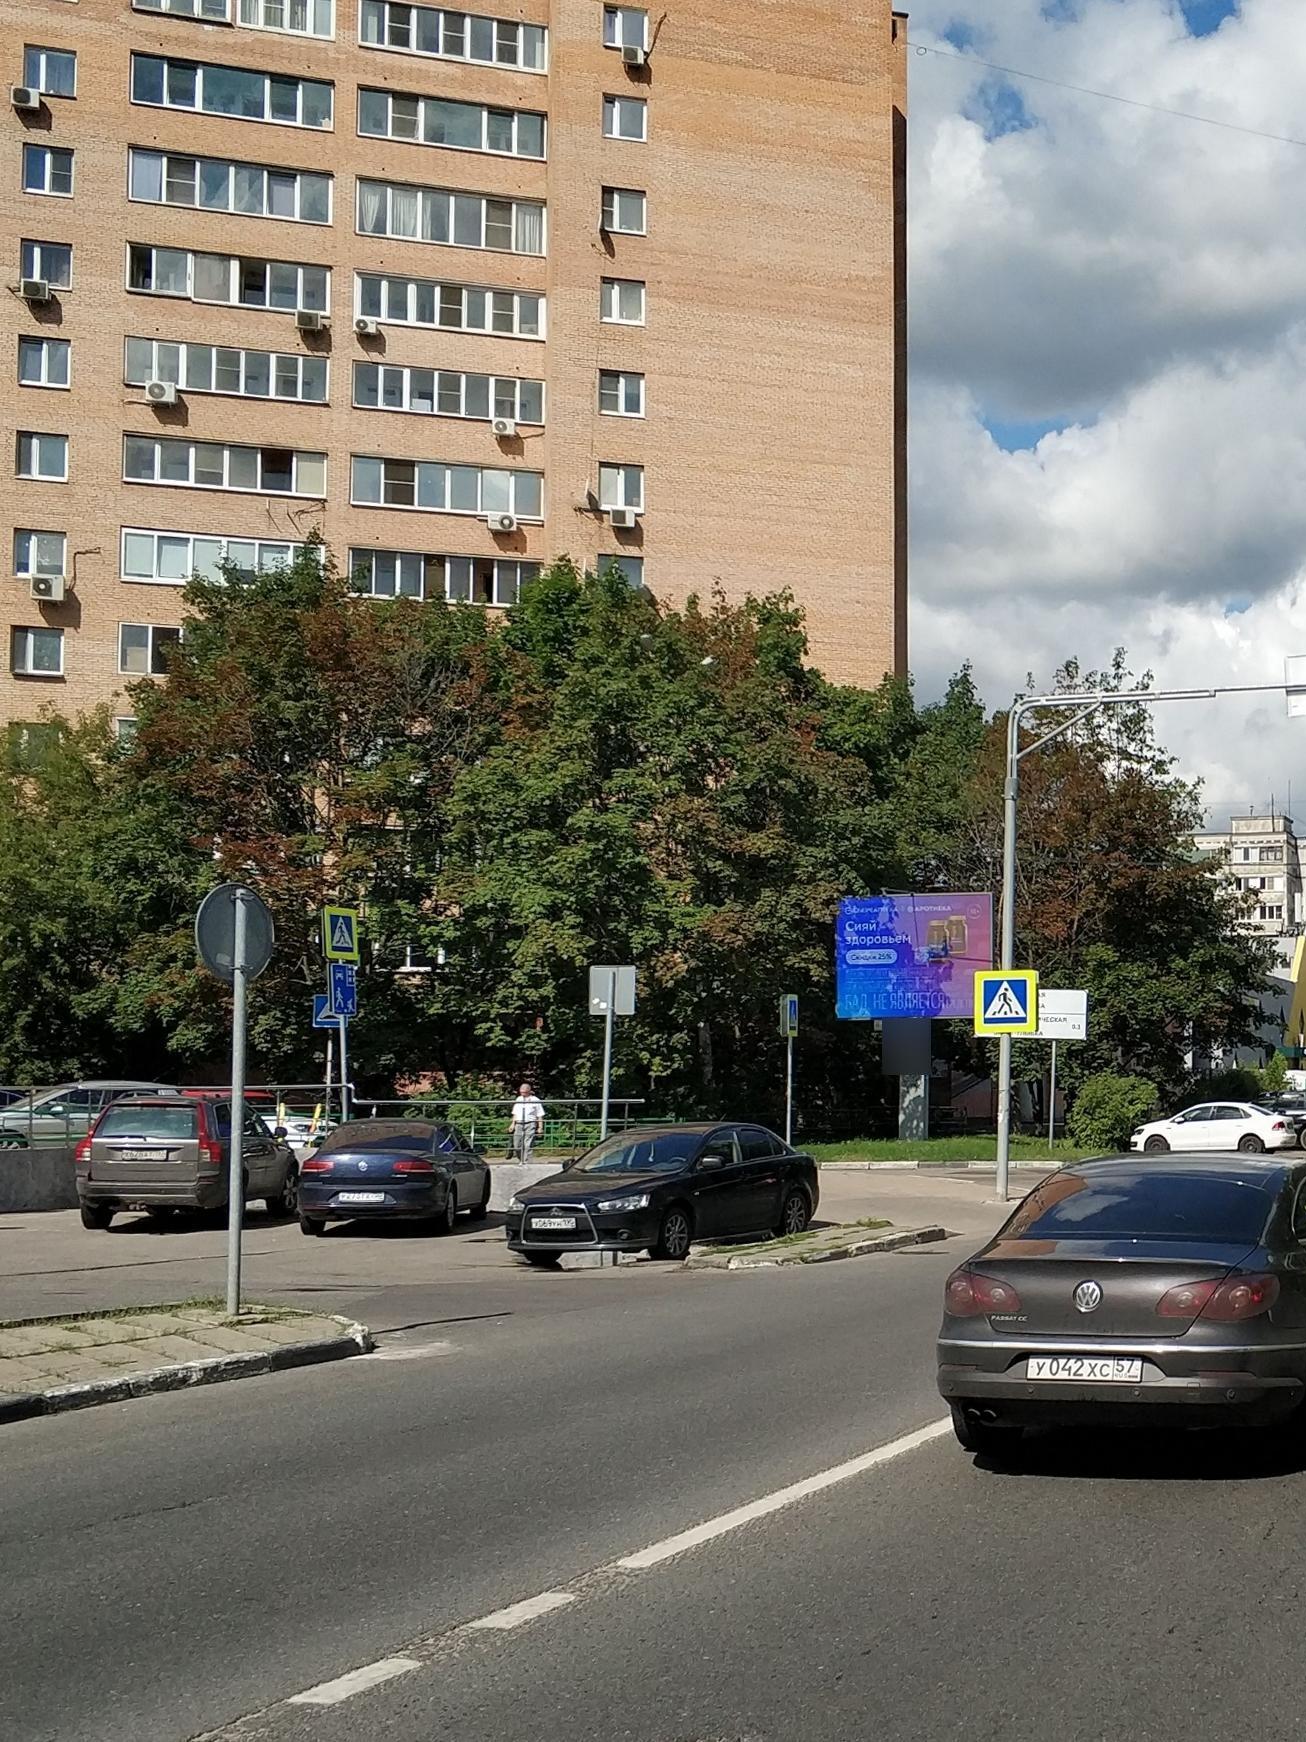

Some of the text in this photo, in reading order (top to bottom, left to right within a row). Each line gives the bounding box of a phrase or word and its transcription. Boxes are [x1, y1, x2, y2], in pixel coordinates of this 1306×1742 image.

[845, 920, 877, 932] Сияй
[845, 935, 912, 946] здоровьем
[1115, 1357, 1135, 1374] 57
